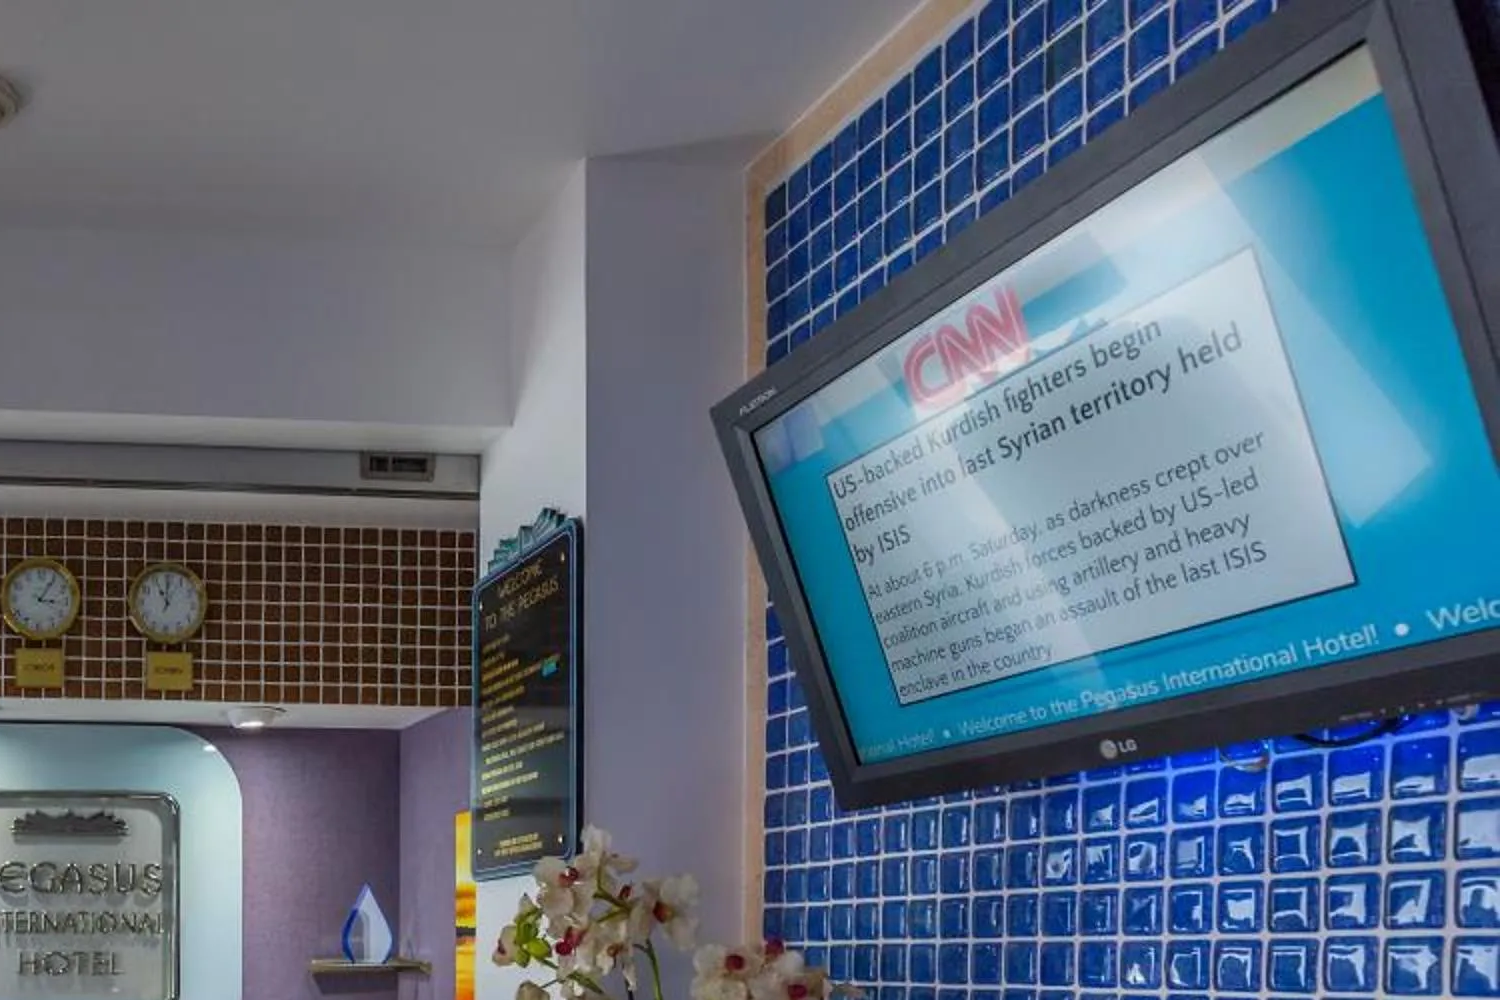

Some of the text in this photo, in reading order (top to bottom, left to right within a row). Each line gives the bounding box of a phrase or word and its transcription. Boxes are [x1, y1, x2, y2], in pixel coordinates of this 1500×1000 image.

[903, 282, 1032, 406] CNN
[833, 319, 1162, 499] US-backed Kurdish fighters begin
[845, 319, 1243, 531] offensive into last Syrian territory held
[853, 524, 911, 566] by ISIS
[874, 597, 923, 625] eastern
[964, 557, 1023, 591] Kurdish
[1025, 540, 1077, 570] forces
[1078, 509, 1148, 550] backed
[1149, 503, 1175, 527] by
[1180, 466, 1260, 513] US-led
[884, 567, 921, 595] about
[1046, 513, 1066, 531] as
[1068, 478, 1151, 522] darkness
[1154, 454, 1211, 488] crept
[1214, 431, 1263, 465] over
[883, 514, 1250, 650] coalition aircraft and using artillery and heavy
[890, 541, 1267, 673] machine guns began an assault of the last ISIS
[899, 671, 949, 697] enclave
[951, 667, 966, 682] in
[967, 660, 990, 679] the
[957, 711, 1028, 736] Welcome
[1030, 705, 1047, 721] to
[1051, 698, 1077, 715] the
[1079, 680, 1159, 709] Pegasus
[1162, 645, 1298, 690] International
[1302, 623, 1379, 661] Hotel!
[1117, 738, 1137, 752] LG
[18, 951, 125, 977] HOTEL
